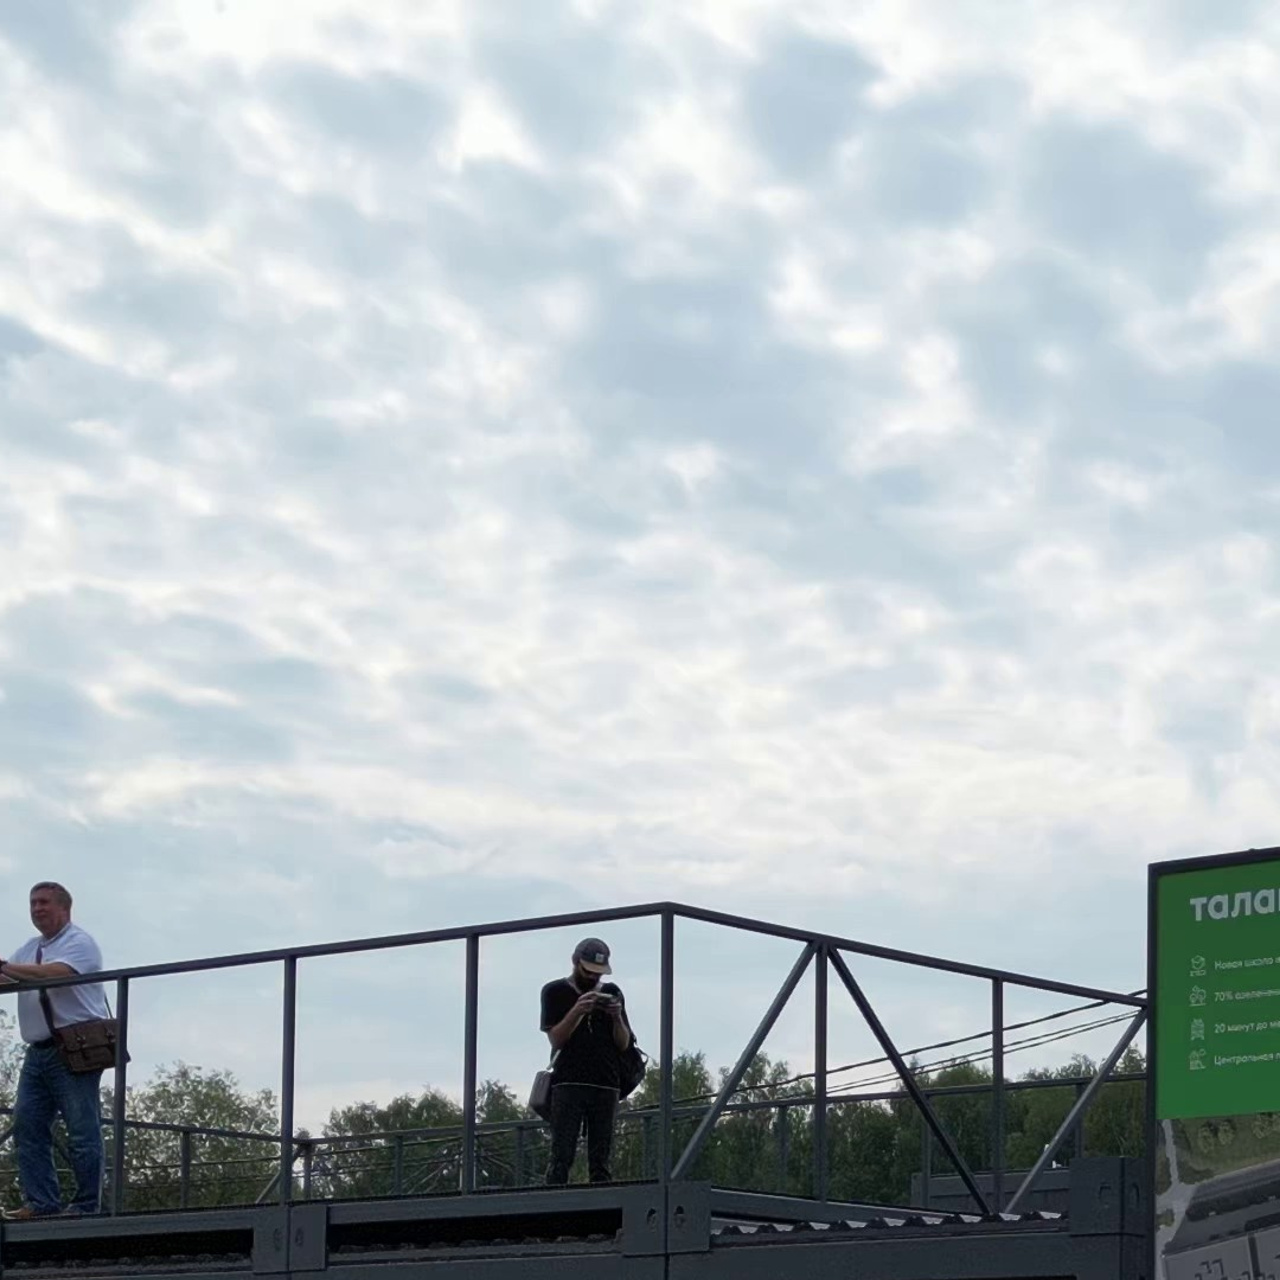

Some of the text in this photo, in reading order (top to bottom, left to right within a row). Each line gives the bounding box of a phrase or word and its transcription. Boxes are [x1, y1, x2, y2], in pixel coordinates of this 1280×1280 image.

[1214, 960, 1243, 970] Новая
[1243, 957, 1274, 968] школа
[1214, 990, 1234, 1002] 70%
[1214, 1023, 1226, 1034] 20
[1227, 1022, 1255, 1033] минут
[1255, 1021, 1268, 1031] до
[1214, 1053, 1274, 1067] Центральная
